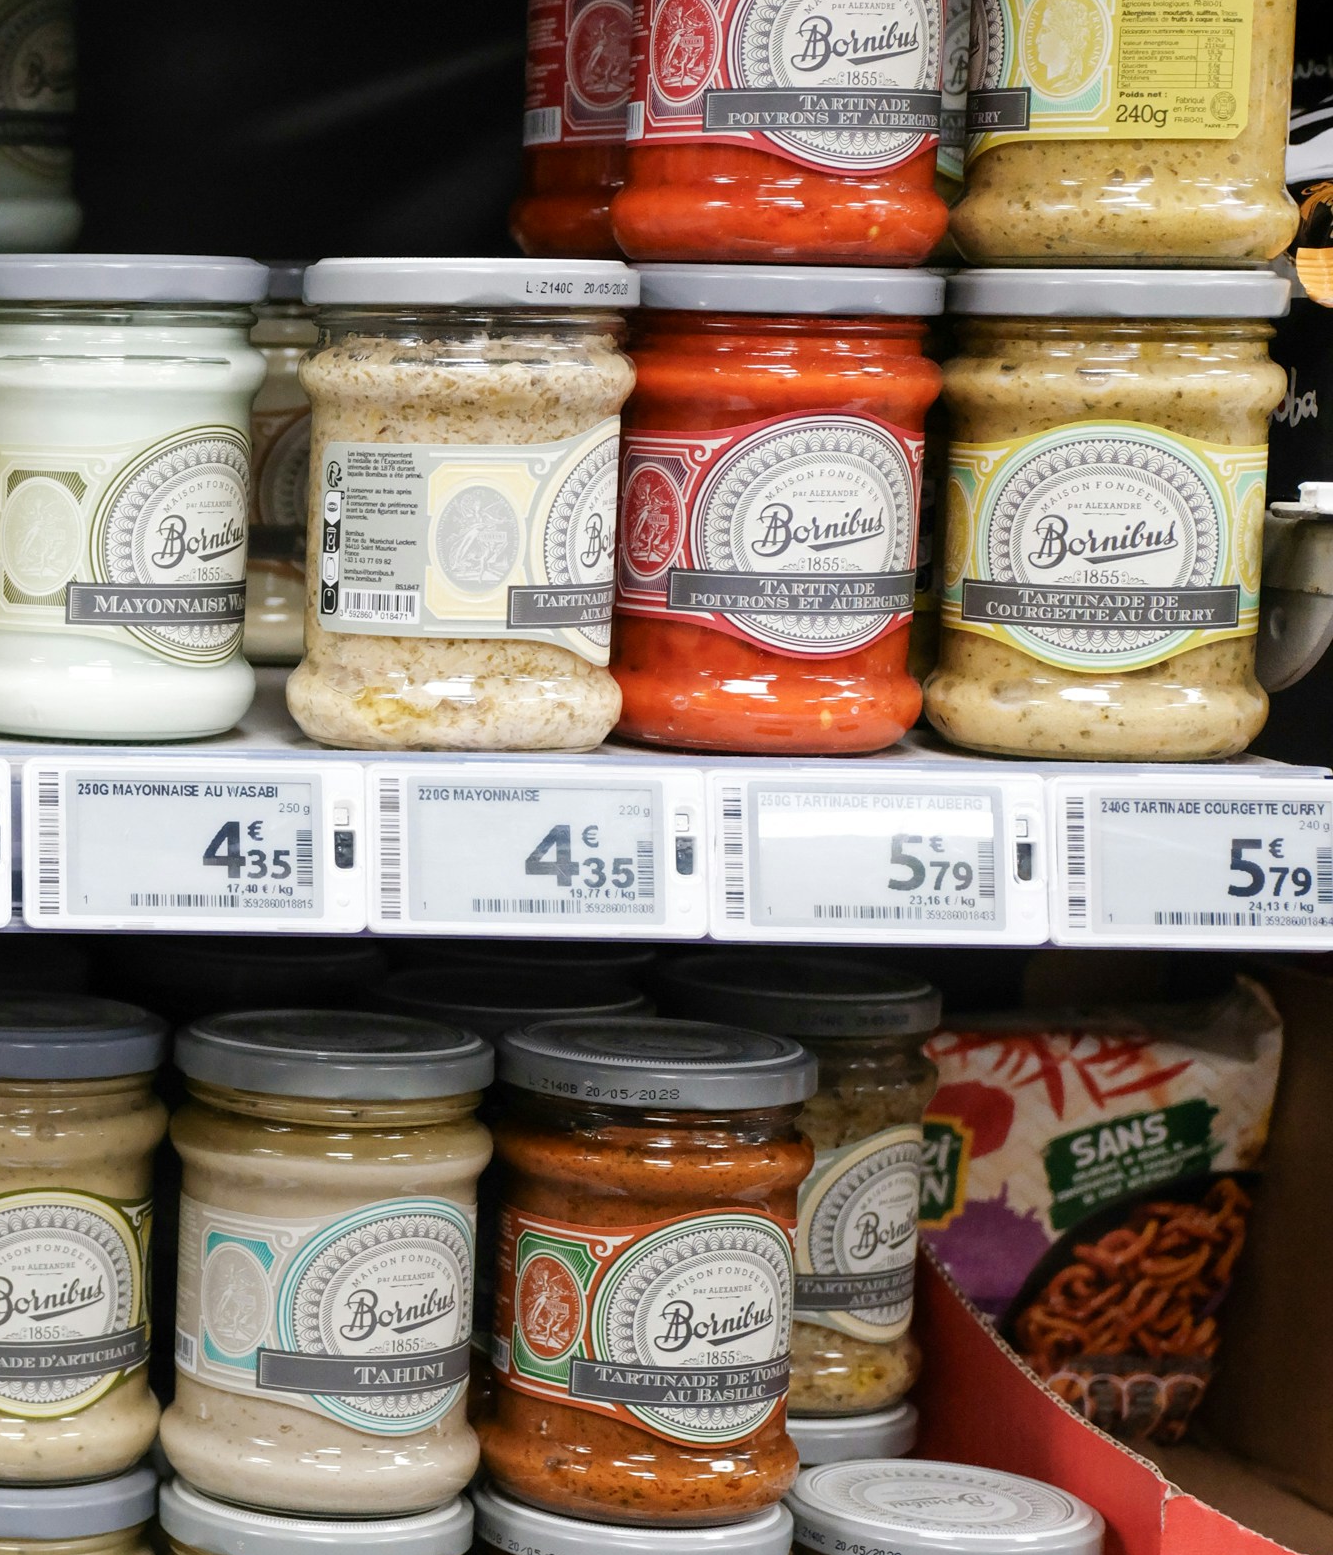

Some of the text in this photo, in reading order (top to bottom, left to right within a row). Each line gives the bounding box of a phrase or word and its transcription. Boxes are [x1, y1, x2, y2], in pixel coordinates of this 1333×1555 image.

[1116, 102, 1169, 128] 240g
[1029, 515, 1179, 569] Bornibus
[1017, 590, 1179, 609] TARTINADE DE
[986, 603, 1216, 622] COURGETTE AU CURRY
[78, 784, 279, 799] 250G MAYONNAISE AU WASABI
[1070, 1113, 1167, 1164] SANS
